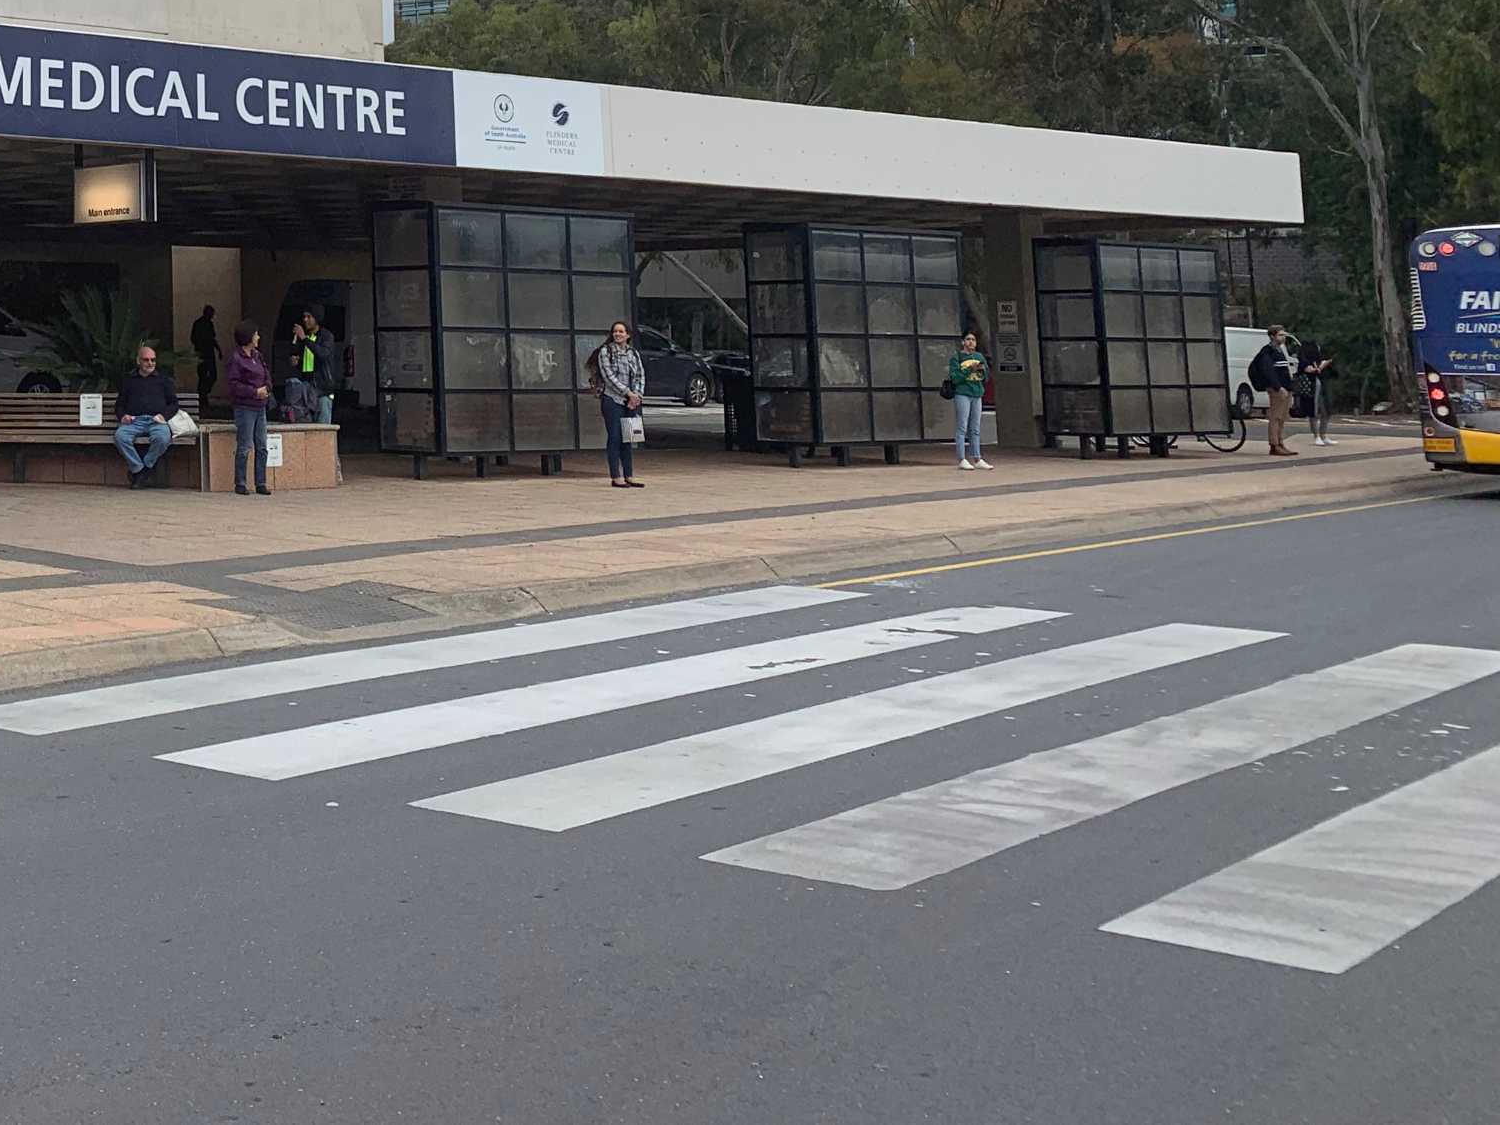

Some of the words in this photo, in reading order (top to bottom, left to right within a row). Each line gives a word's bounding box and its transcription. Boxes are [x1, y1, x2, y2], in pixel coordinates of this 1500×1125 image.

[236, 77, 406, 135] CENTRE
[88, 208, 103, 217] Main
[103, 207, 131, 216] entrance
